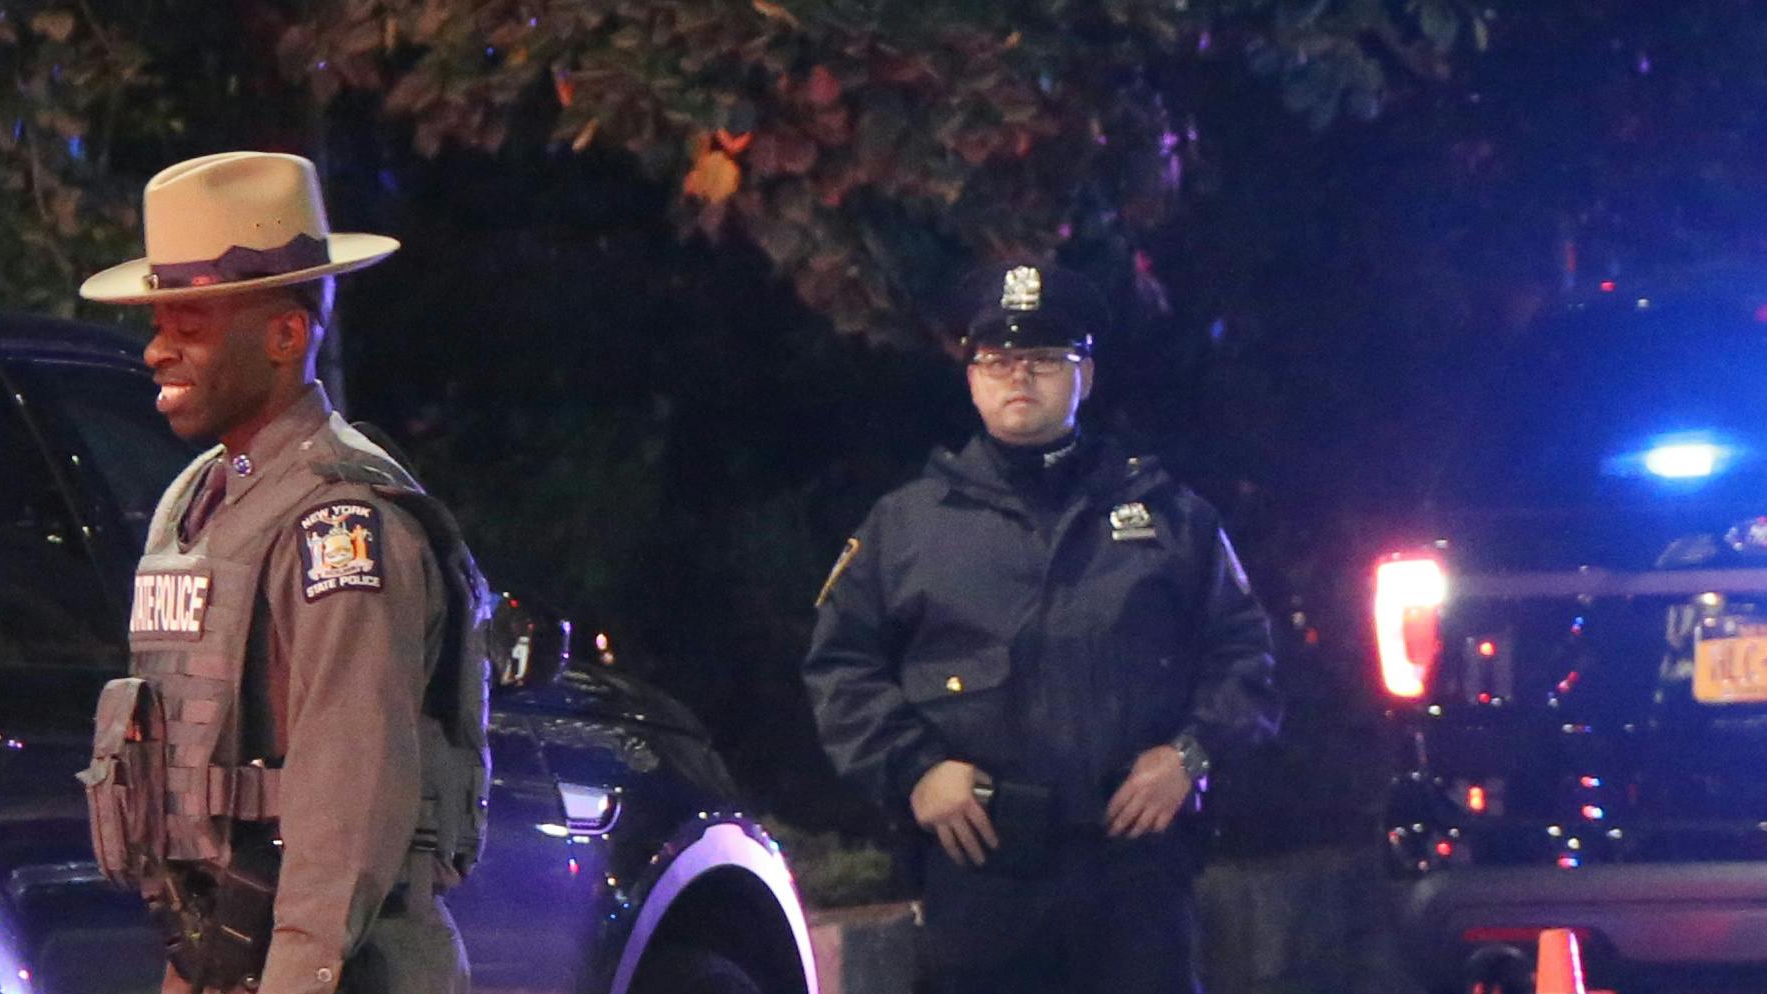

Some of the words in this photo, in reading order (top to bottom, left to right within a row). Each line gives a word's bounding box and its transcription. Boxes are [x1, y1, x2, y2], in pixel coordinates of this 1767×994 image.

[300, 508, 330, 529] NEW
[332, 505, 372, 518] YORK
[306, 578, 337, 598] STATE
[338, 575, 381, 588] POLICE
[154, 574, 209, 632] POLICE
